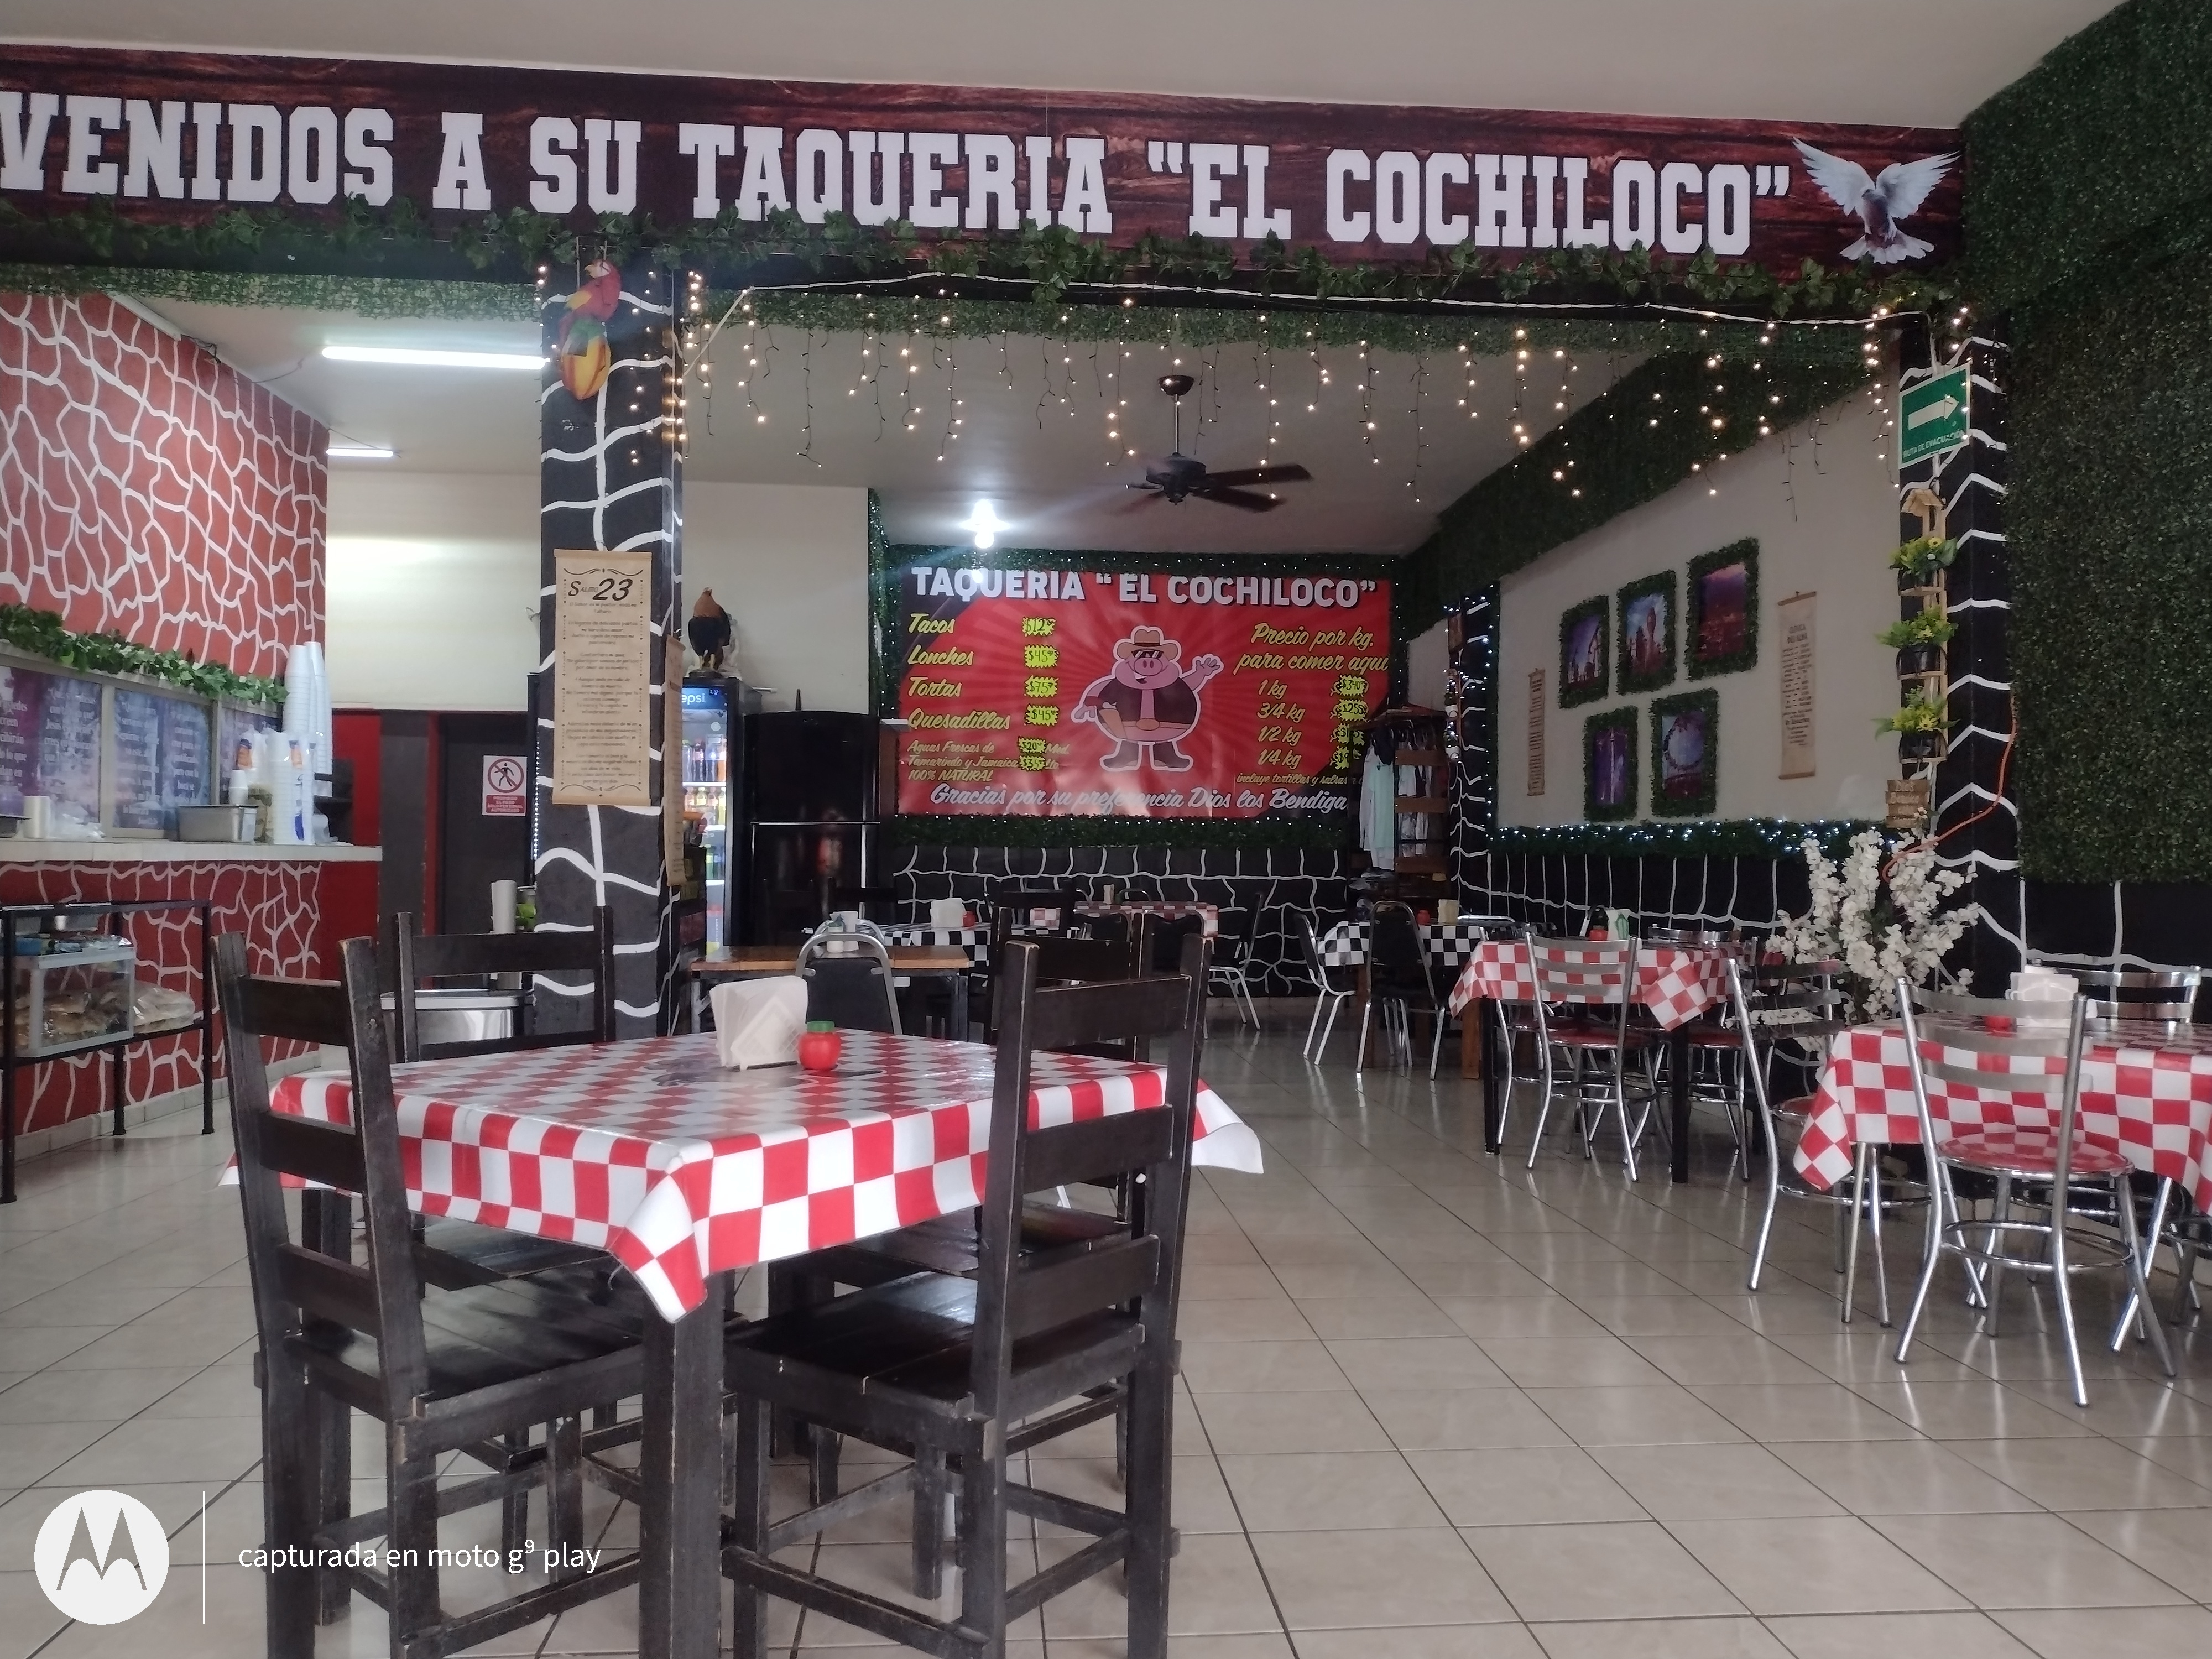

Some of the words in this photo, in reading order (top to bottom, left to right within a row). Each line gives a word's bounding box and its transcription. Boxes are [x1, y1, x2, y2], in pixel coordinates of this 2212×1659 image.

[433, 112, 491, 210] A
[530, 117, 641, 215] SU
[679, 123, 1112, 233] TAQUERIA
[592, 578, 634, 601] 23
[911, 567, 1086, 601] TAQUERIA
[909, 613, 955, 633] Tacos
[1251, 623, 1310, 645] Precio
[1308, 630, 1347, 652] por
[1348, 626, 1374, 651] kg.
[908, 644, 974, 666] Lonches
[1233, 653, 1284, 675] para
[1287, 655, 1344, 670] comer
[908, 676, 962, 697] Tortas
[1258, 679, 1269, 695] 1
[1267, 679, 1288, 700] kg
[681, 692, 706, 705] epsi
[907, 708, 1010, 729] Quesadillas
[1257, 702, 1286, 719] 3/4
[1285, 703, 1306, 723] kg
[907, 740, 940, 753] Aguas
[941, 740, 980, 753] Frescas
[982, 742, 995, 753] de
[1258, 726, 1282, 742] 1/2
[1282, 726, 1302, 746] kg
[907, 755, 962, 768] Tamarindo
[964, 759, 972, 769] y
[973, 756, 1018, 768] Jamaica
[1258, 749, 1281, 765] 1/4
[1281, 749, 1302, 770] kg
[907, 770, 936, 781] 100%
[938, 769, 994, 781] NATURAL
[1237, 773, 1270, 785] incluye
[1272, 773, 1310, 784] tortillas
[1310, 775, 1319, 786] y
[1319, 775, 1347, 784] salsas
[930, 783, 1006, 805] Gracias
[1005, 790, 1046, 811] por
[1047, 790, 1072, 805] su
[1070, 787, 1185, 814] prefeencia
[1188, 787, 1231, 808] Dios
[1236, 789, 1264, 808] los
[1270, 787, 1348, 813] Bendiga
